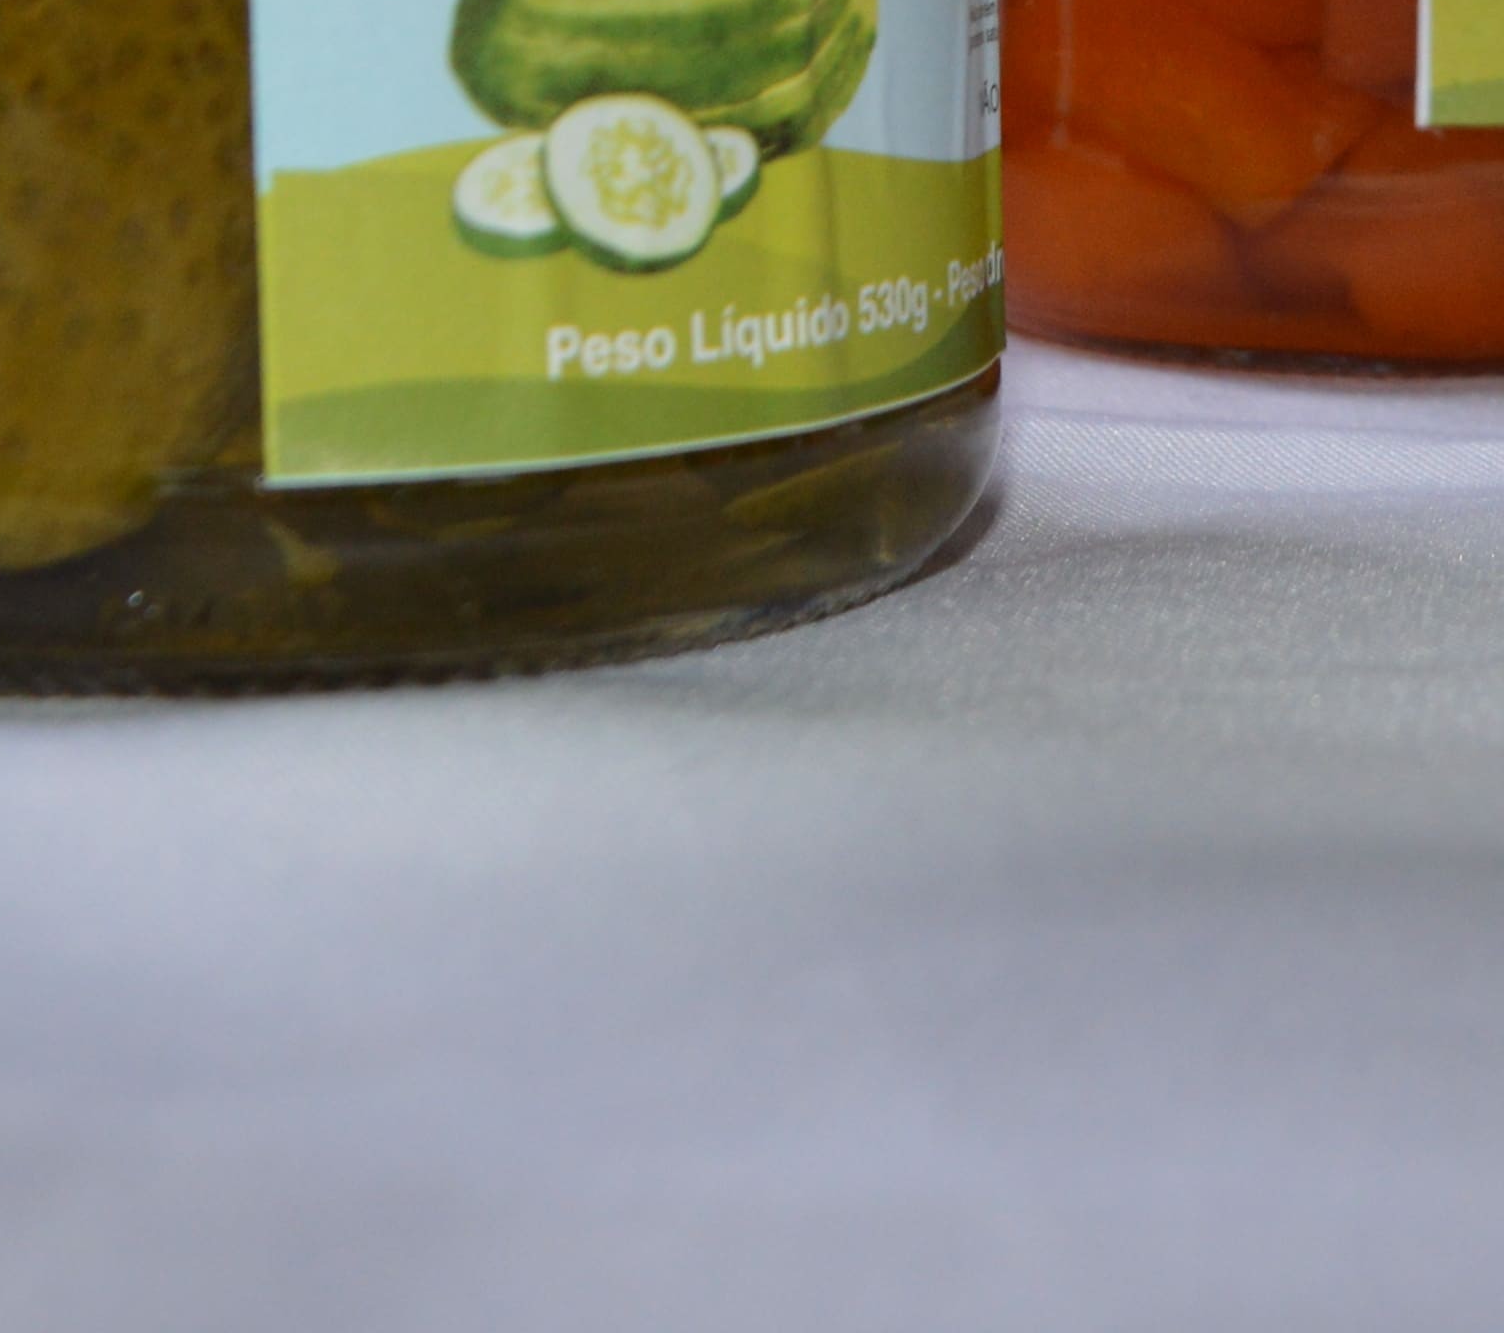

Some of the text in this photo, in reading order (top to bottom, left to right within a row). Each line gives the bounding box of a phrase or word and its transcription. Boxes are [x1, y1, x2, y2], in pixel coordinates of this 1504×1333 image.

[546, 325, 676, 381] Peso
[690, 294, 849, 367] Líquido
[858, 277, 928, 332] 530g
[947, 258, 984, 305] Peso
